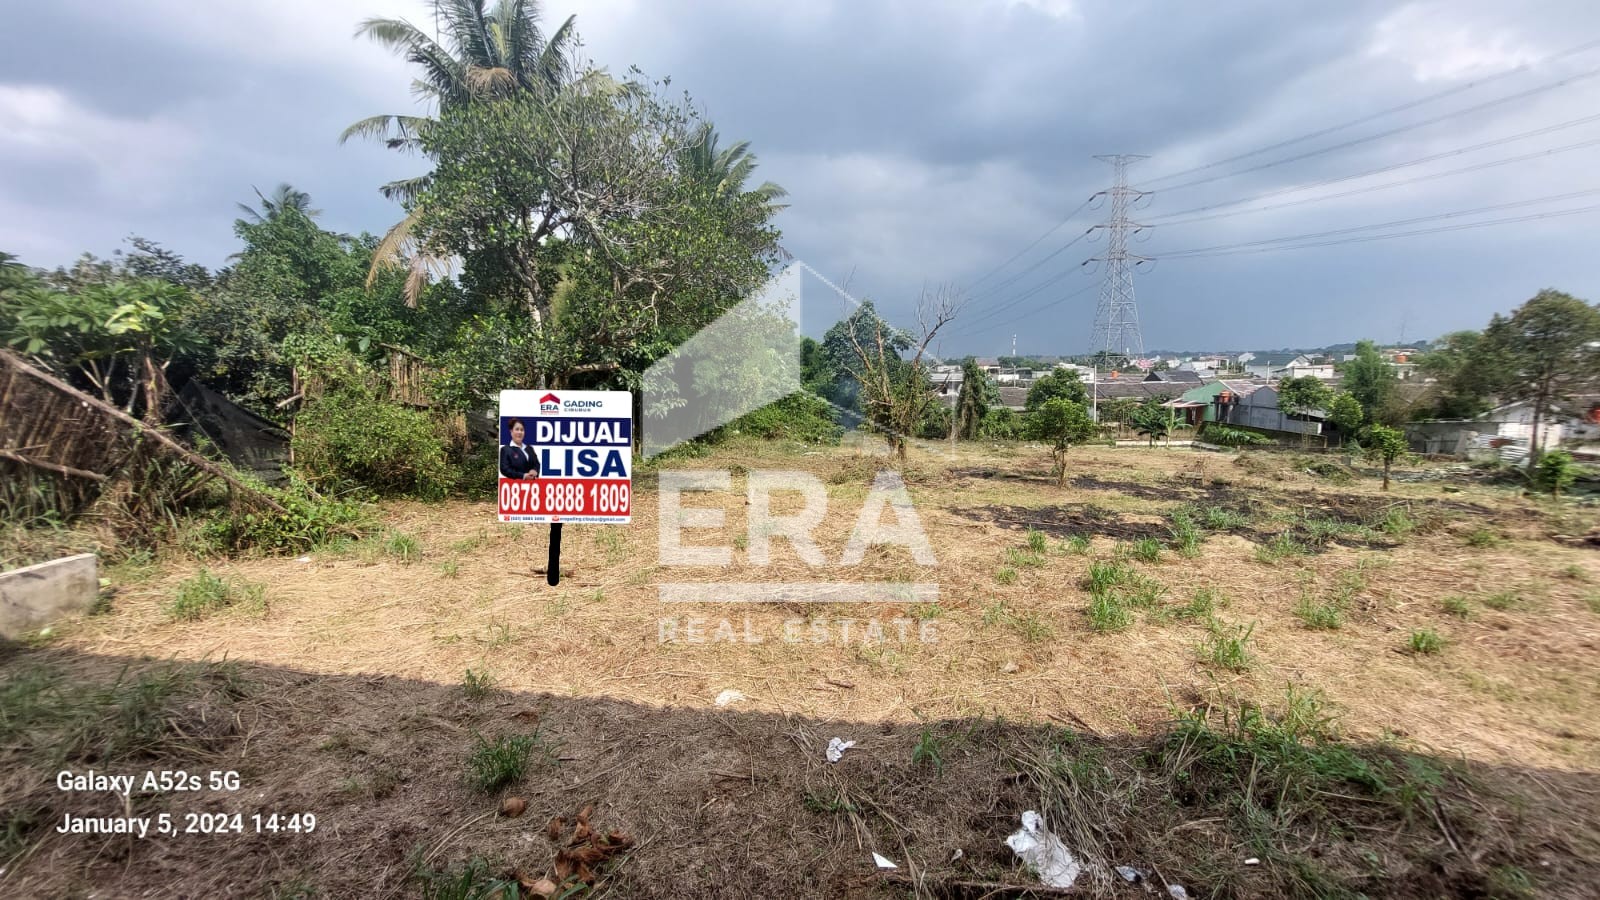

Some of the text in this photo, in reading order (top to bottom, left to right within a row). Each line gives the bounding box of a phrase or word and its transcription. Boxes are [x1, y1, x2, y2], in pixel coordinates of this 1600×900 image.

[563, 400, 603, 408] GADING
[536, 421, 628, 443] DIJUAL
[541, 449, 627, 477] LISA
[500, 482, 629, 512] 0878 8888 1809
